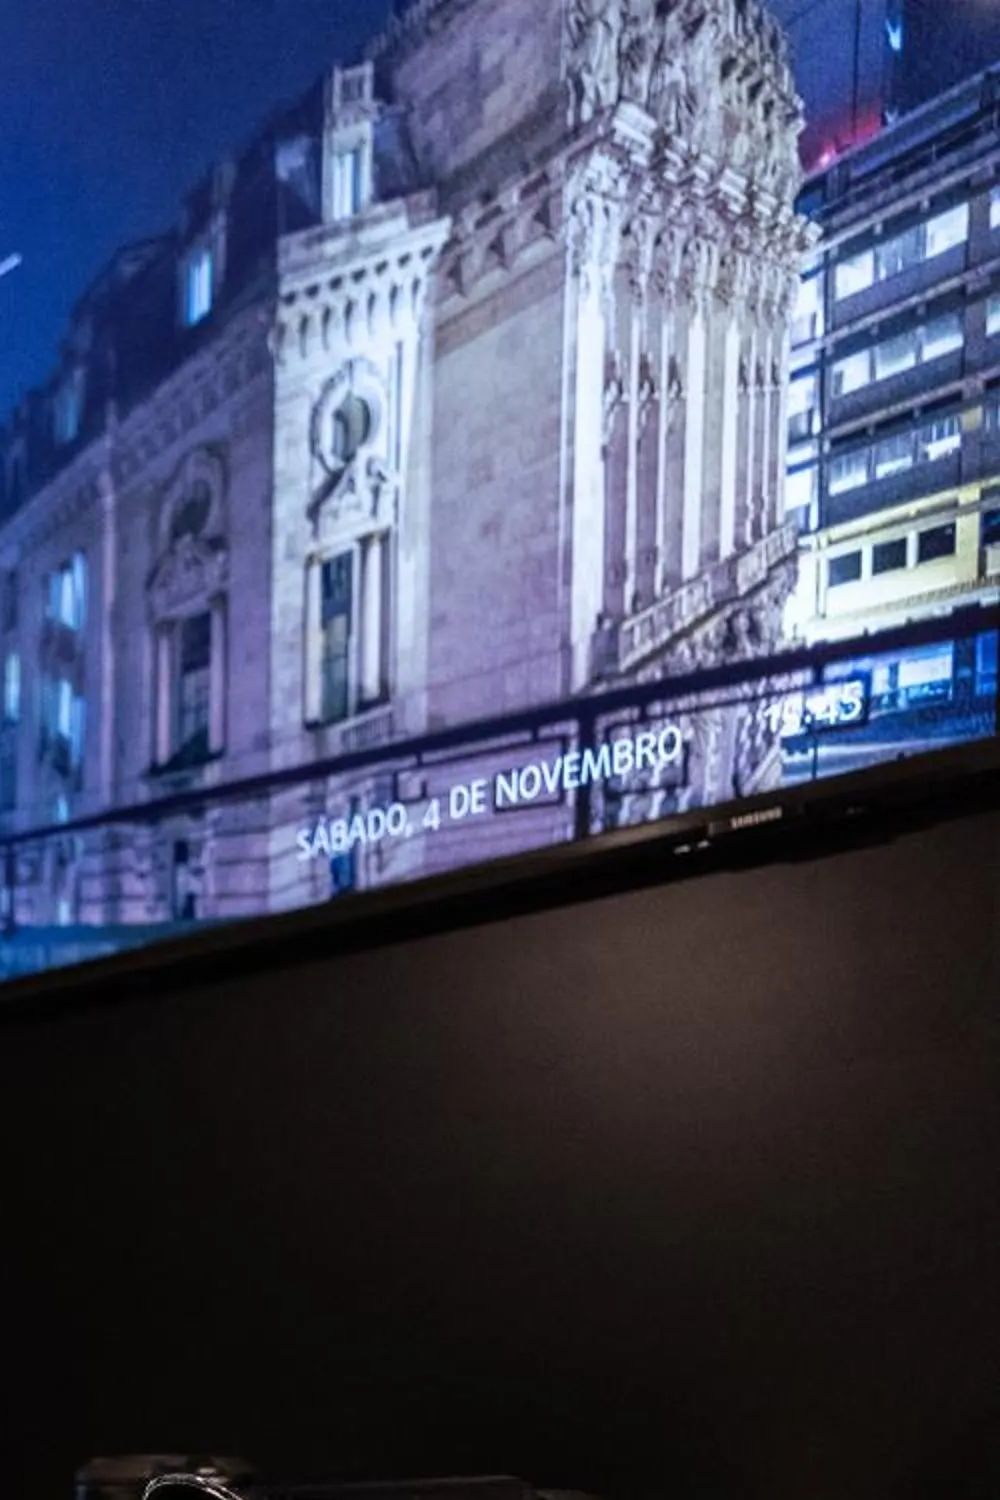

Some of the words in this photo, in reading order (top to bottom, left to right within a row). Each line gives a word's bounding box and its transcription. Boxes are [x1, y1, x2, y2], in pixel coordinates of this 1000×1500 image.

[296, 802, 415, 861] SÁBADO,
[422, 799, 441, 832] 4
[449, 778, 487, 820] DE
[497, 725, 683, 808] NOVEMBRO
